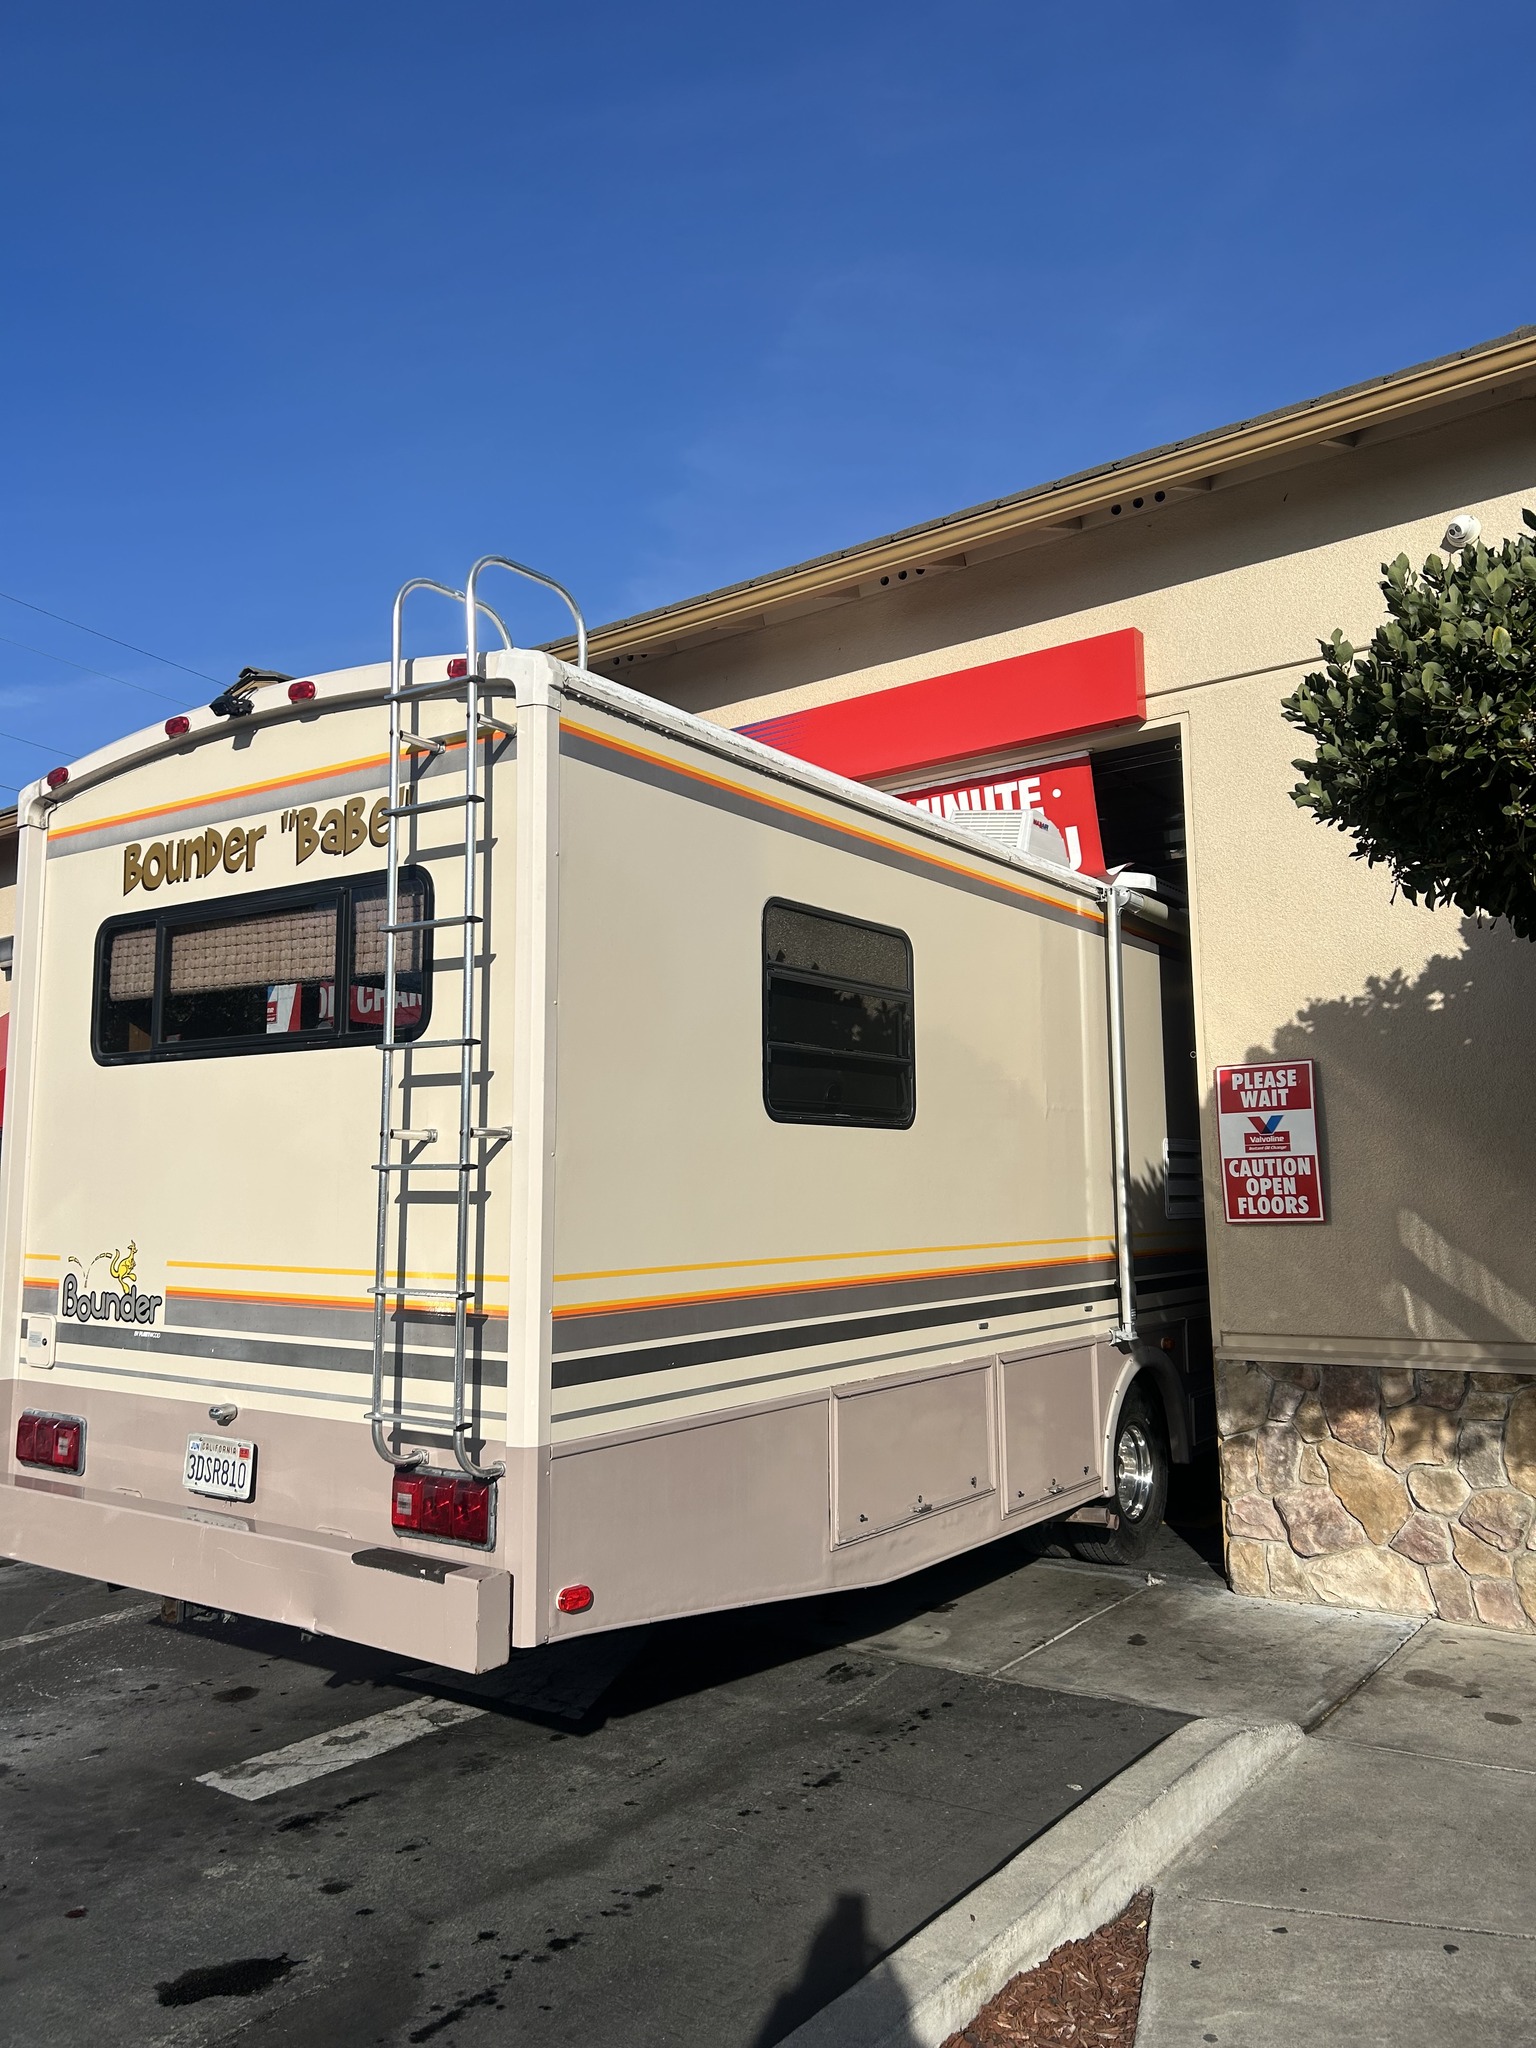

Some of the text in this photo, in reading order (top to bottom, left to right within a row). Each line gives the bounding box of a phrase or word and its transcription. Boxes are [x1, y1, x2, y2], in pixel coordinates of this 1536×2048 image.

[1232, 1069, 1297, 1090] PLEASE
[1240, 1088, 1289, 1108] WAIT
[1228, 1157, 1311, 1177] CAUTION
[1246, 1177, 1297, 1196] OPEN
[1237, 1195, 1310, 1215] FLOORS
[62, 1273, 163, 1324] Bounder
[202, 1442, 237, 1455] CALIFORNIA
[187, 1454, 247, 1489] 3DSR810
